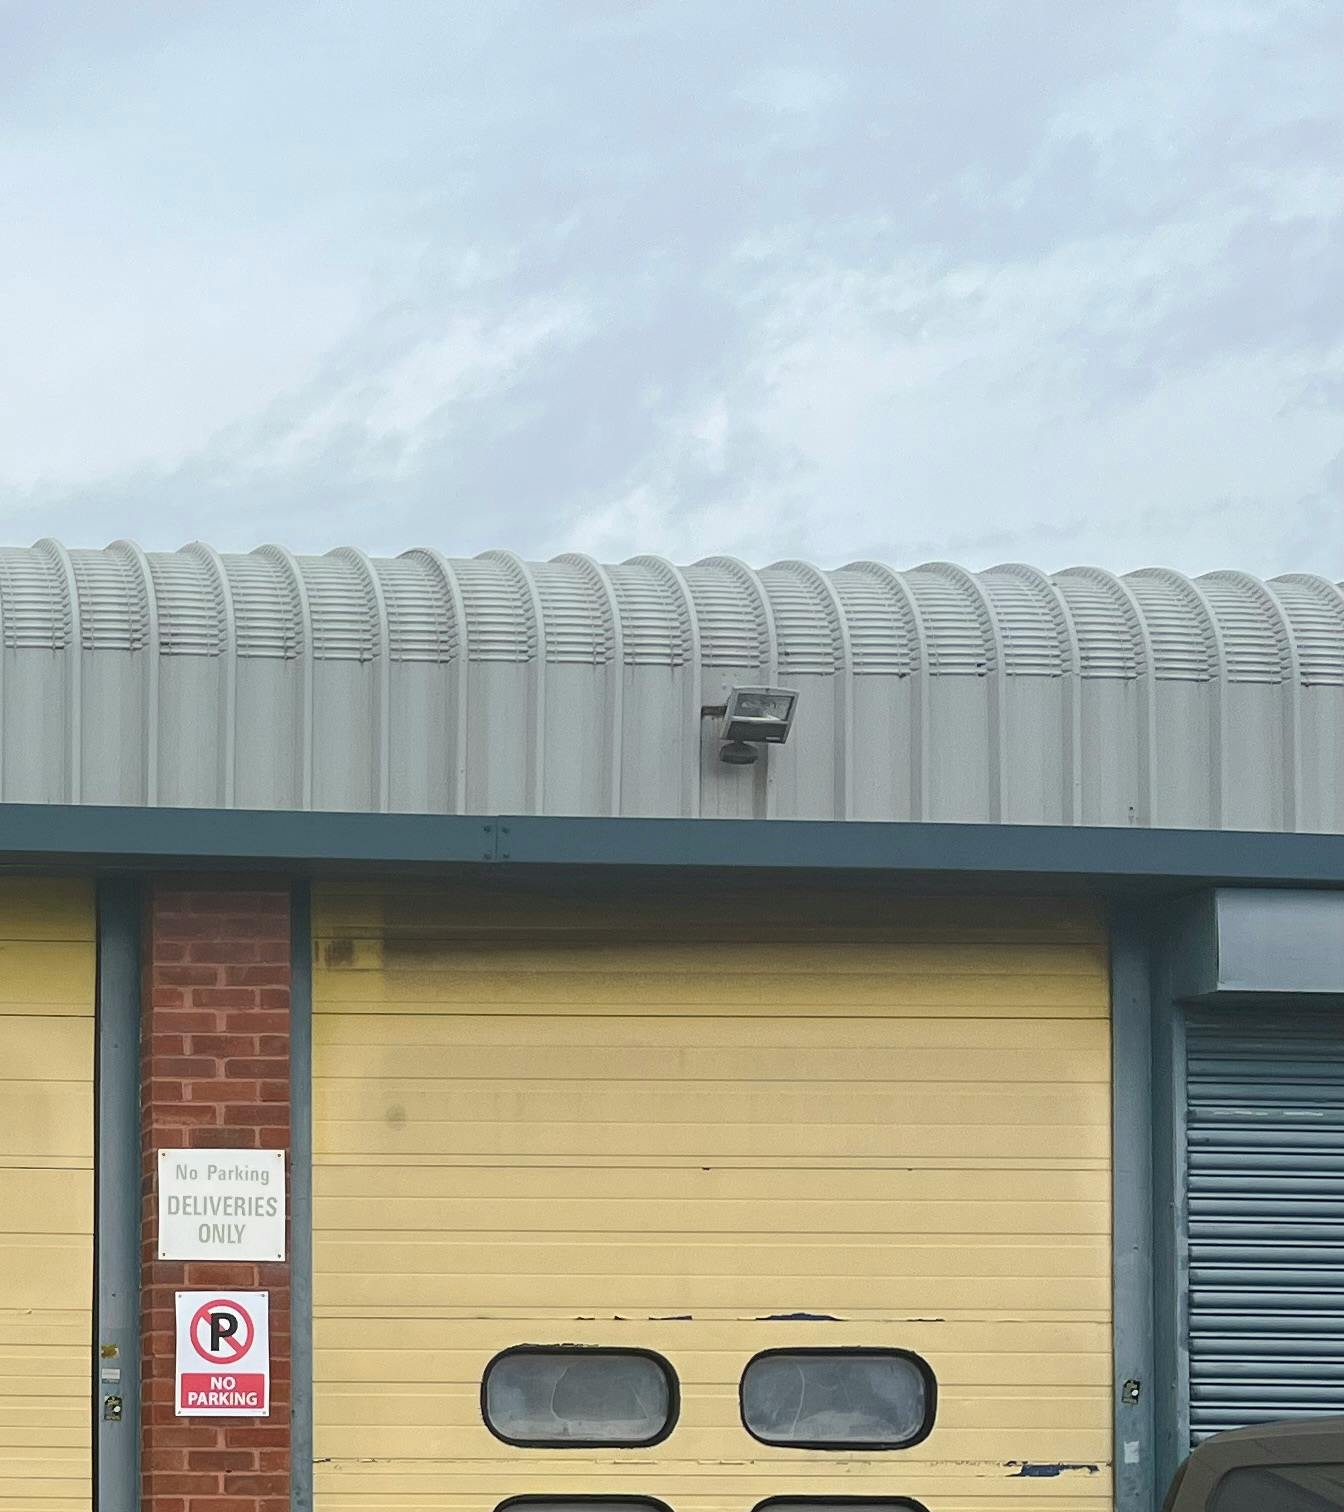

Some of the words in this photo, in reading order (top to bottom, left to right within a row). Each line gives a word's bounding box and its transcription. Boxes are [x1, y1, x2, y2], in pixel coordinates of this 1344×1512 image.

[175, 1164, 198, 1180] No
[207, 1164, 270, 1186] Parking
[167, 1195, 278, 1217] DELIVERIES
[198, 1223, 246, 1245] ONLY
[210, 1376, 237, 1390] NO
[188, 1391, 258, 1406] PARKING
